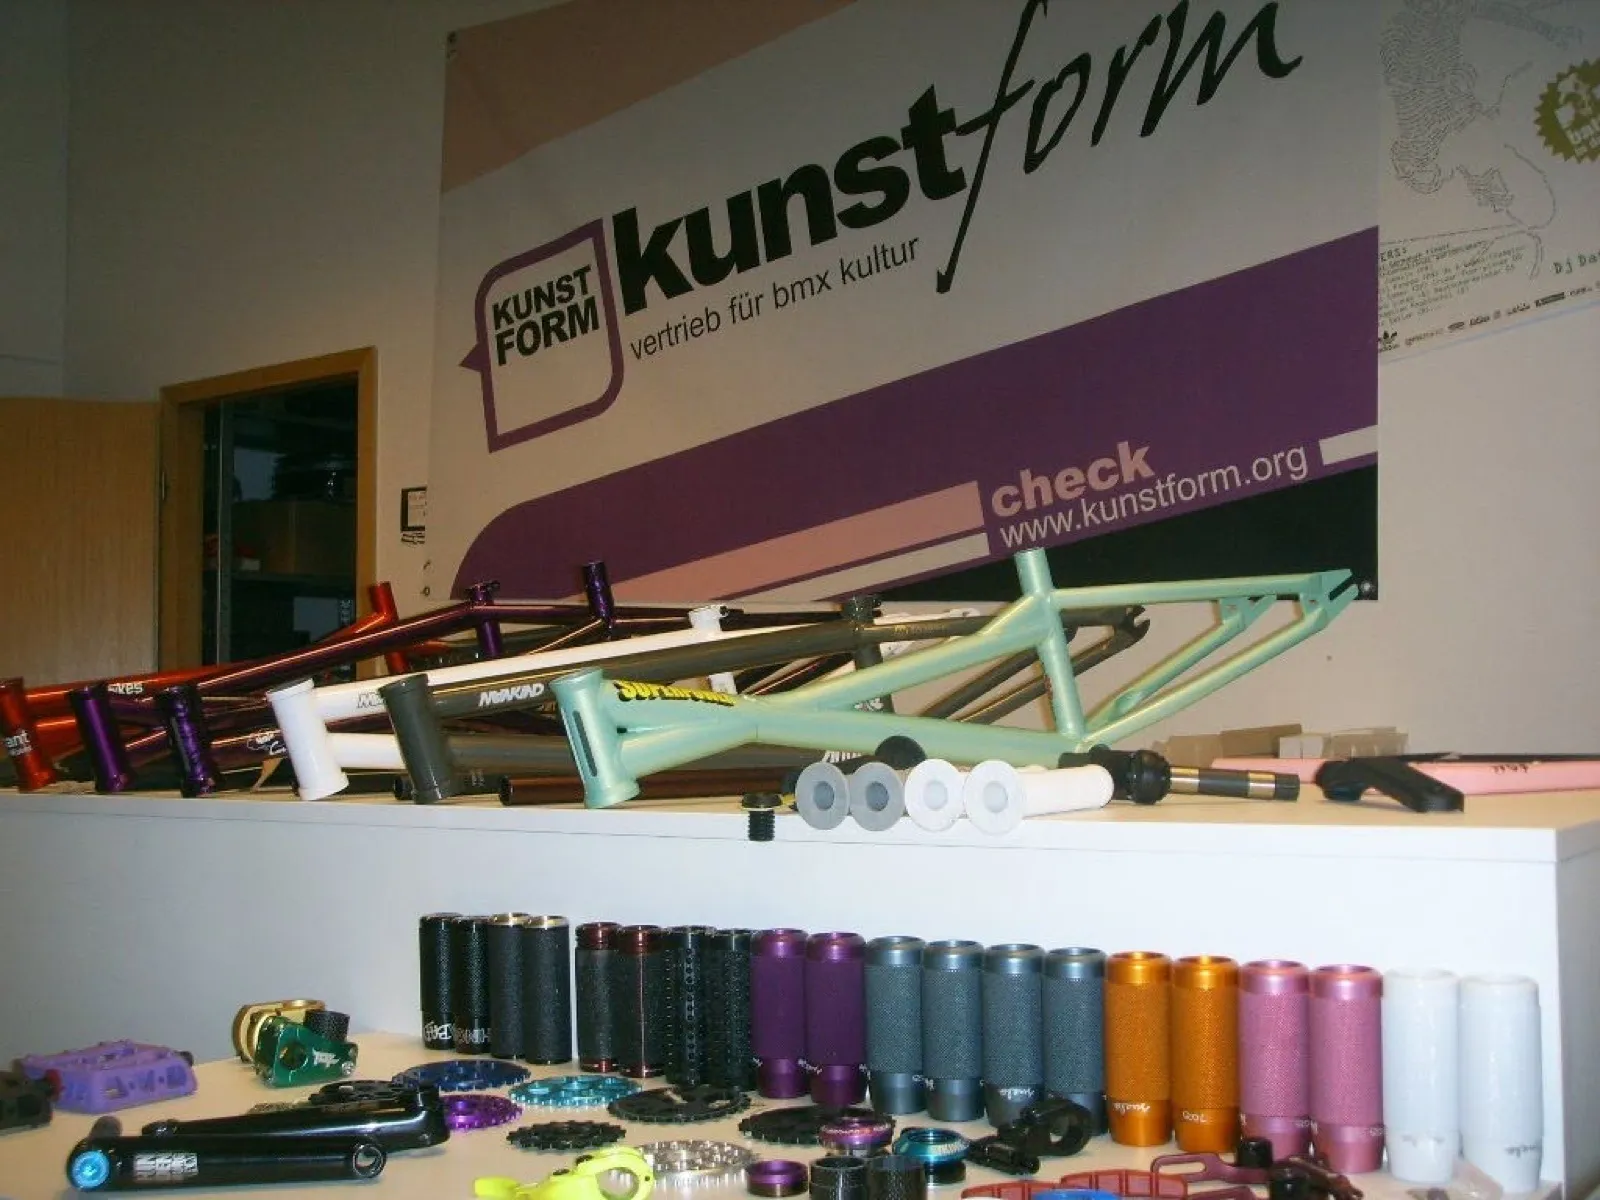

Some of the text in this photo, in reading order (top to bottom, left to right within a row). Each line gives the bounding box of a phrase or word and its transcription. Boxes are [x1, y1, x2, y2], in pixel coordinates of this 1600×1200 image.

[492, 264, 592, 331] KUNST
[494, 296, 600, 367] FORM
[630, 237, 920, 361] vertrieb für bmx kultur
[991, 441, 1156, 518] check
[1000, 445, 1308, 549] www.kunstform.org
